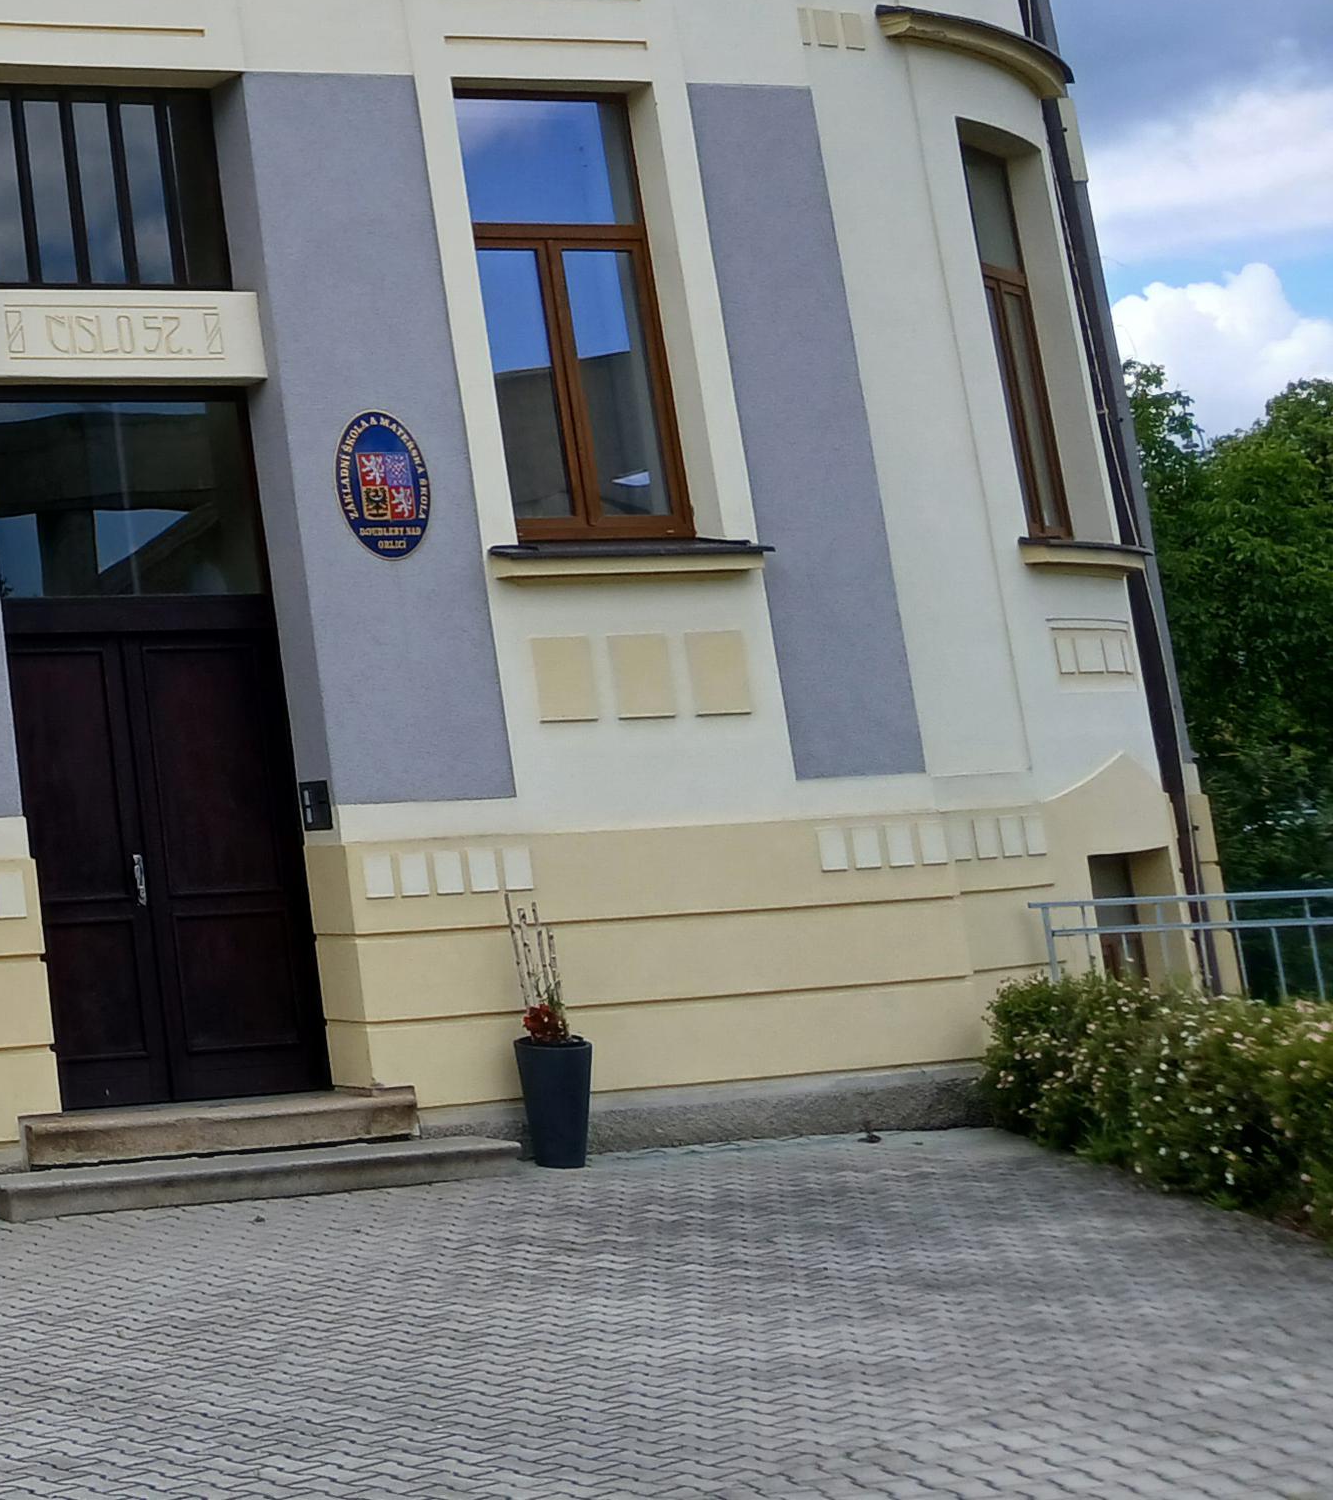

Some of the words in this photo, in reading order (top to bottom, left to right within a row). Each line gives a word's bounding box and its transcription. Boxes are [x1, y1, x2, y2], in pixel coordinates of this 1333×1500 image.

[341, 419, 370, 453] ŠKOLA
[369, 416, 379, 426] A
[418, 477, 429, 519] ŠKOLA
